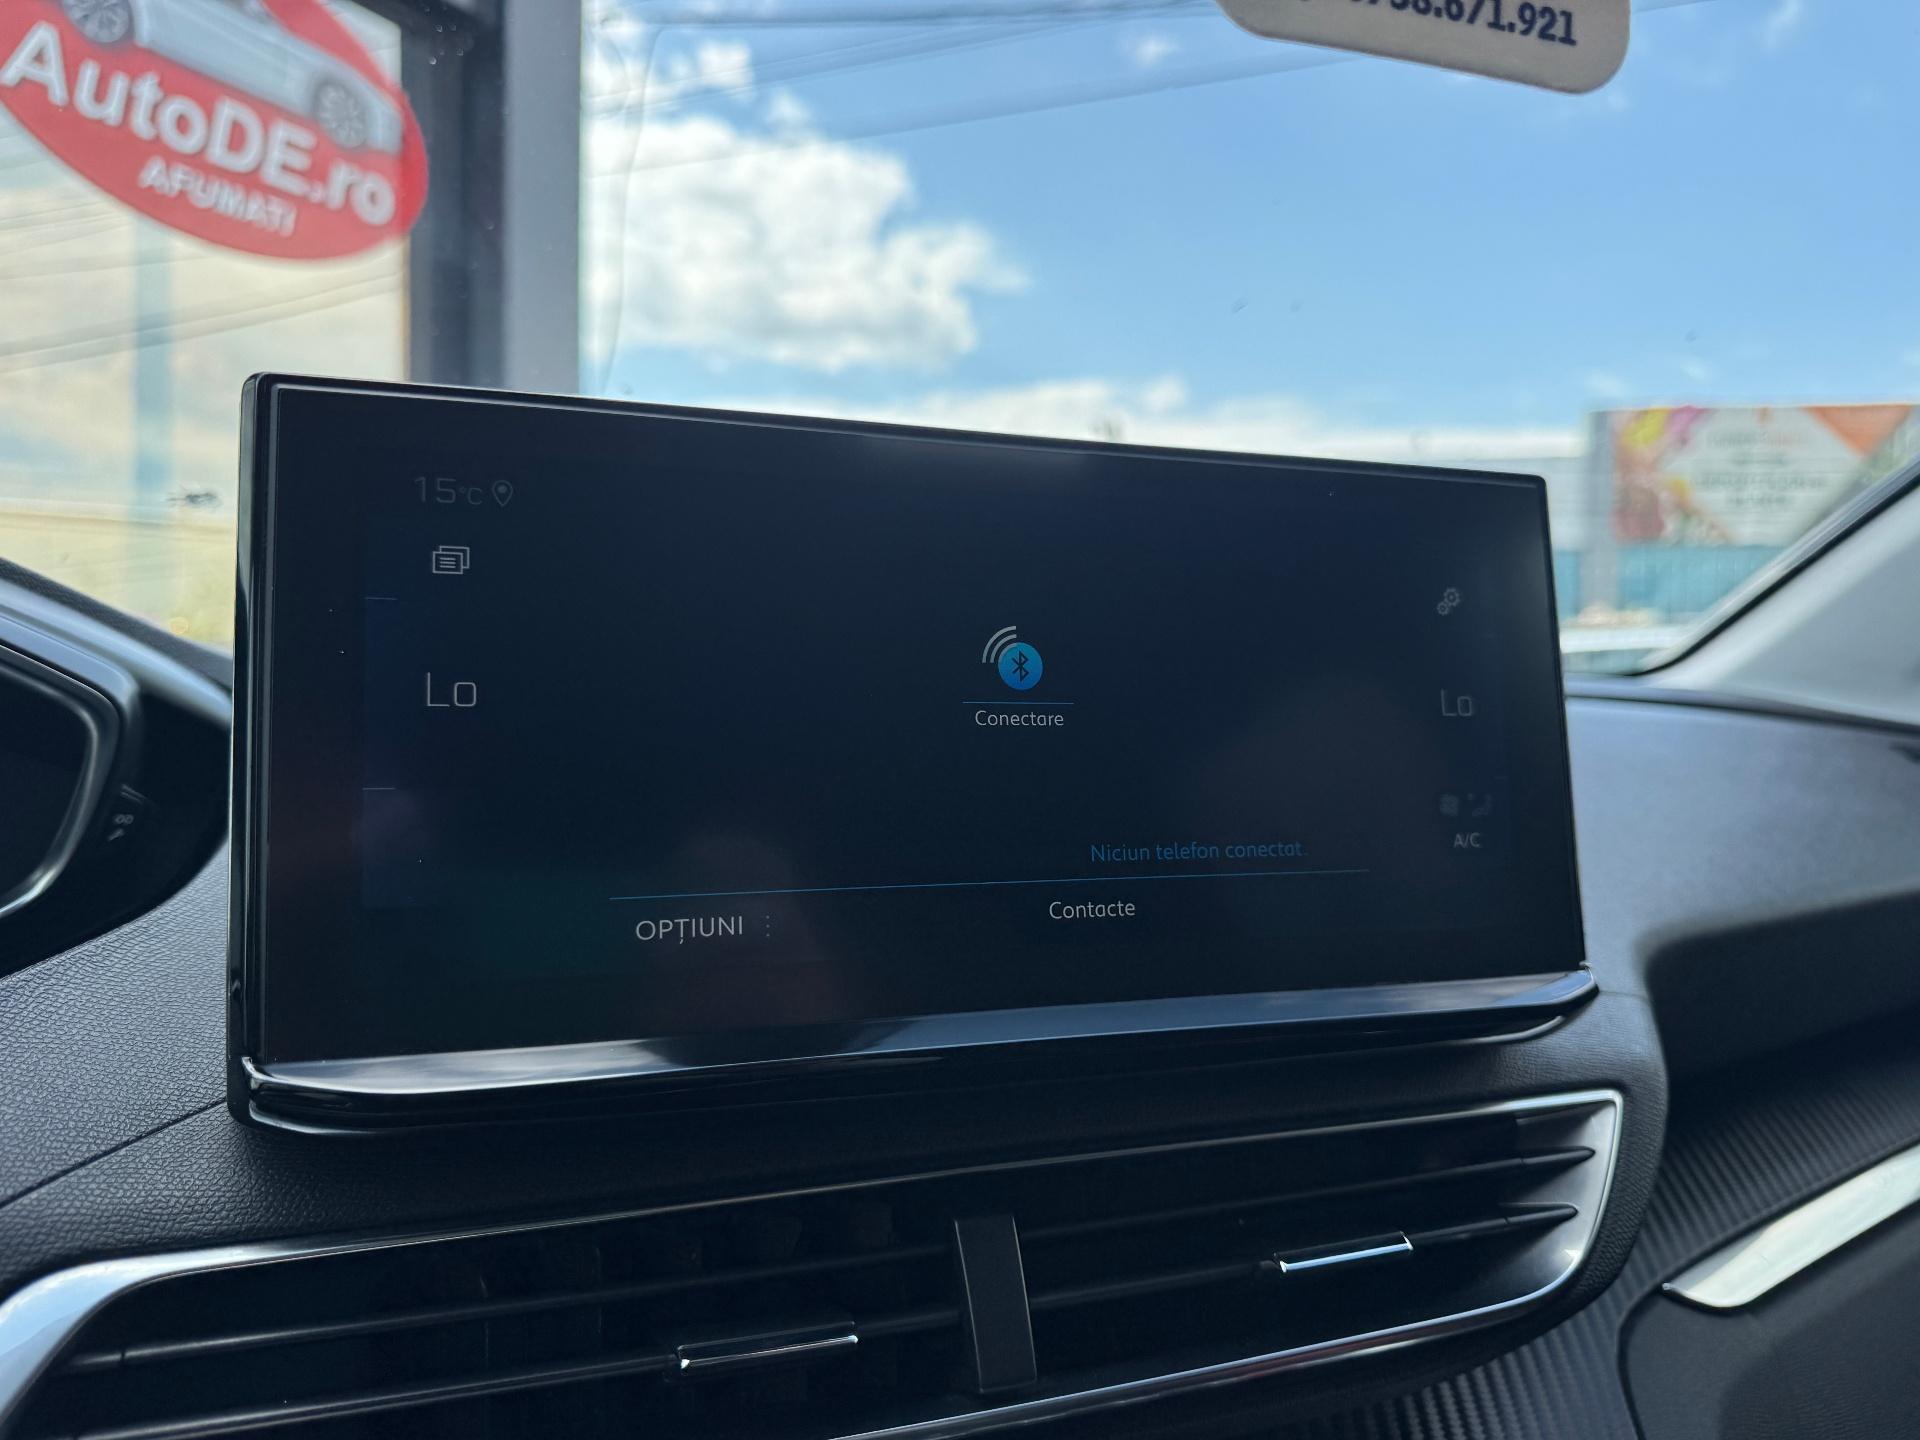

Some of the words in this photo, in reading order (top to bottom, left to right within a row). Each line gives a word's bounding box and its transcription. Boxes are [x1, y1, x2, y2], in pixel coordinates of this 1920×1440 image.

[1, 20, 397, 226] AutoDE.ro
[426, 671, 477, 707] Lo
[1440, 689, 1473, 717] Lo
[975, 710, 1065, 726] Conectare
[1453, 832, 1481, 848] A/C
[1091, 844, 1150, 862] Niciun
[1156, 841, 1220, 860] telefon
[1049, 900, 1136, 919] Contacte
